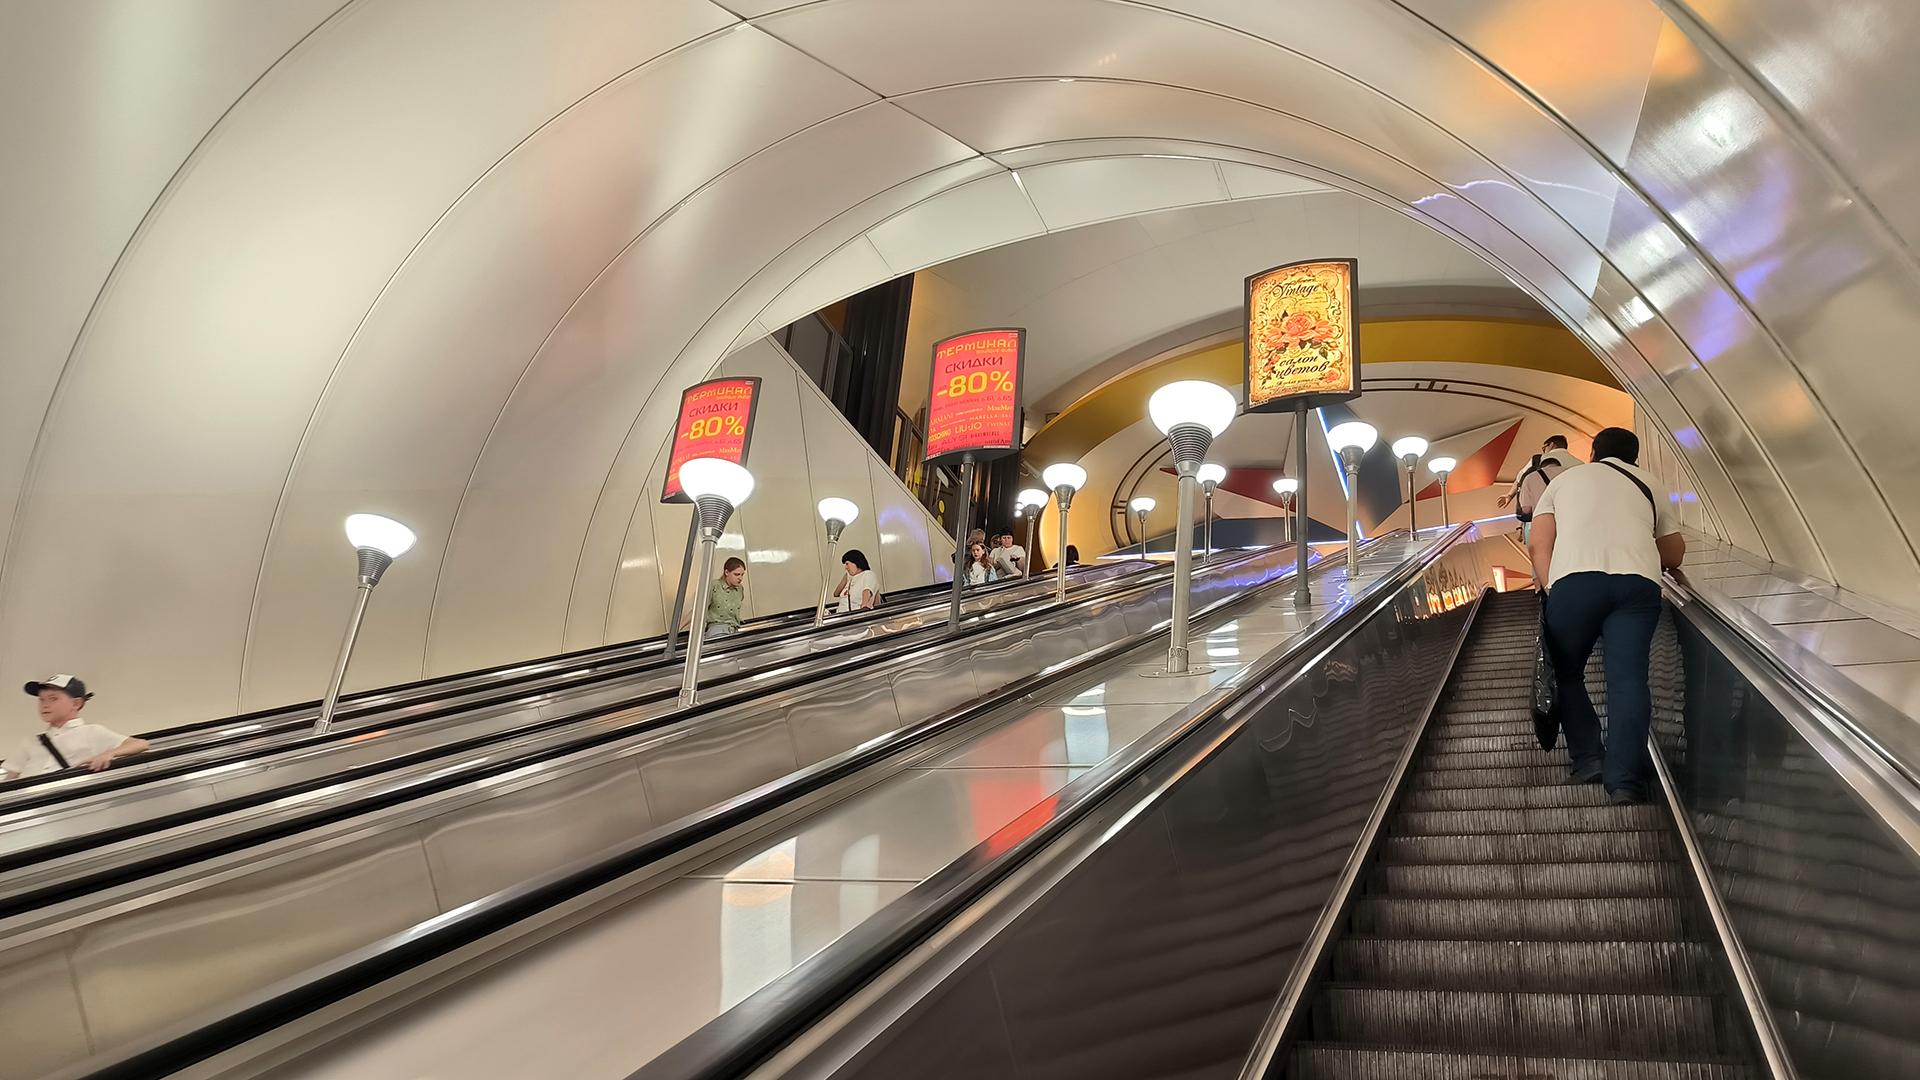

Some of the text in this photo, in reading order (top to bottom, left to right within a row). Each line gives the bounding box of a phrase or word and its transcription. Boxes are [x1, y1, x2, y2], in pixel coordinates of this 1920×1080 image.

[1270, 282, 1320, 298] Vintage
[945, 356, 1003, 374] СКИДКИ
[1276, 361, 1330, 379] цветов
[1279, 355, 1318, 367] салон
[937, 370, 1014, 398] -80%
[689, 402, 738, 418] СКИДКИ
[680, 415, 745, 440] -80%
